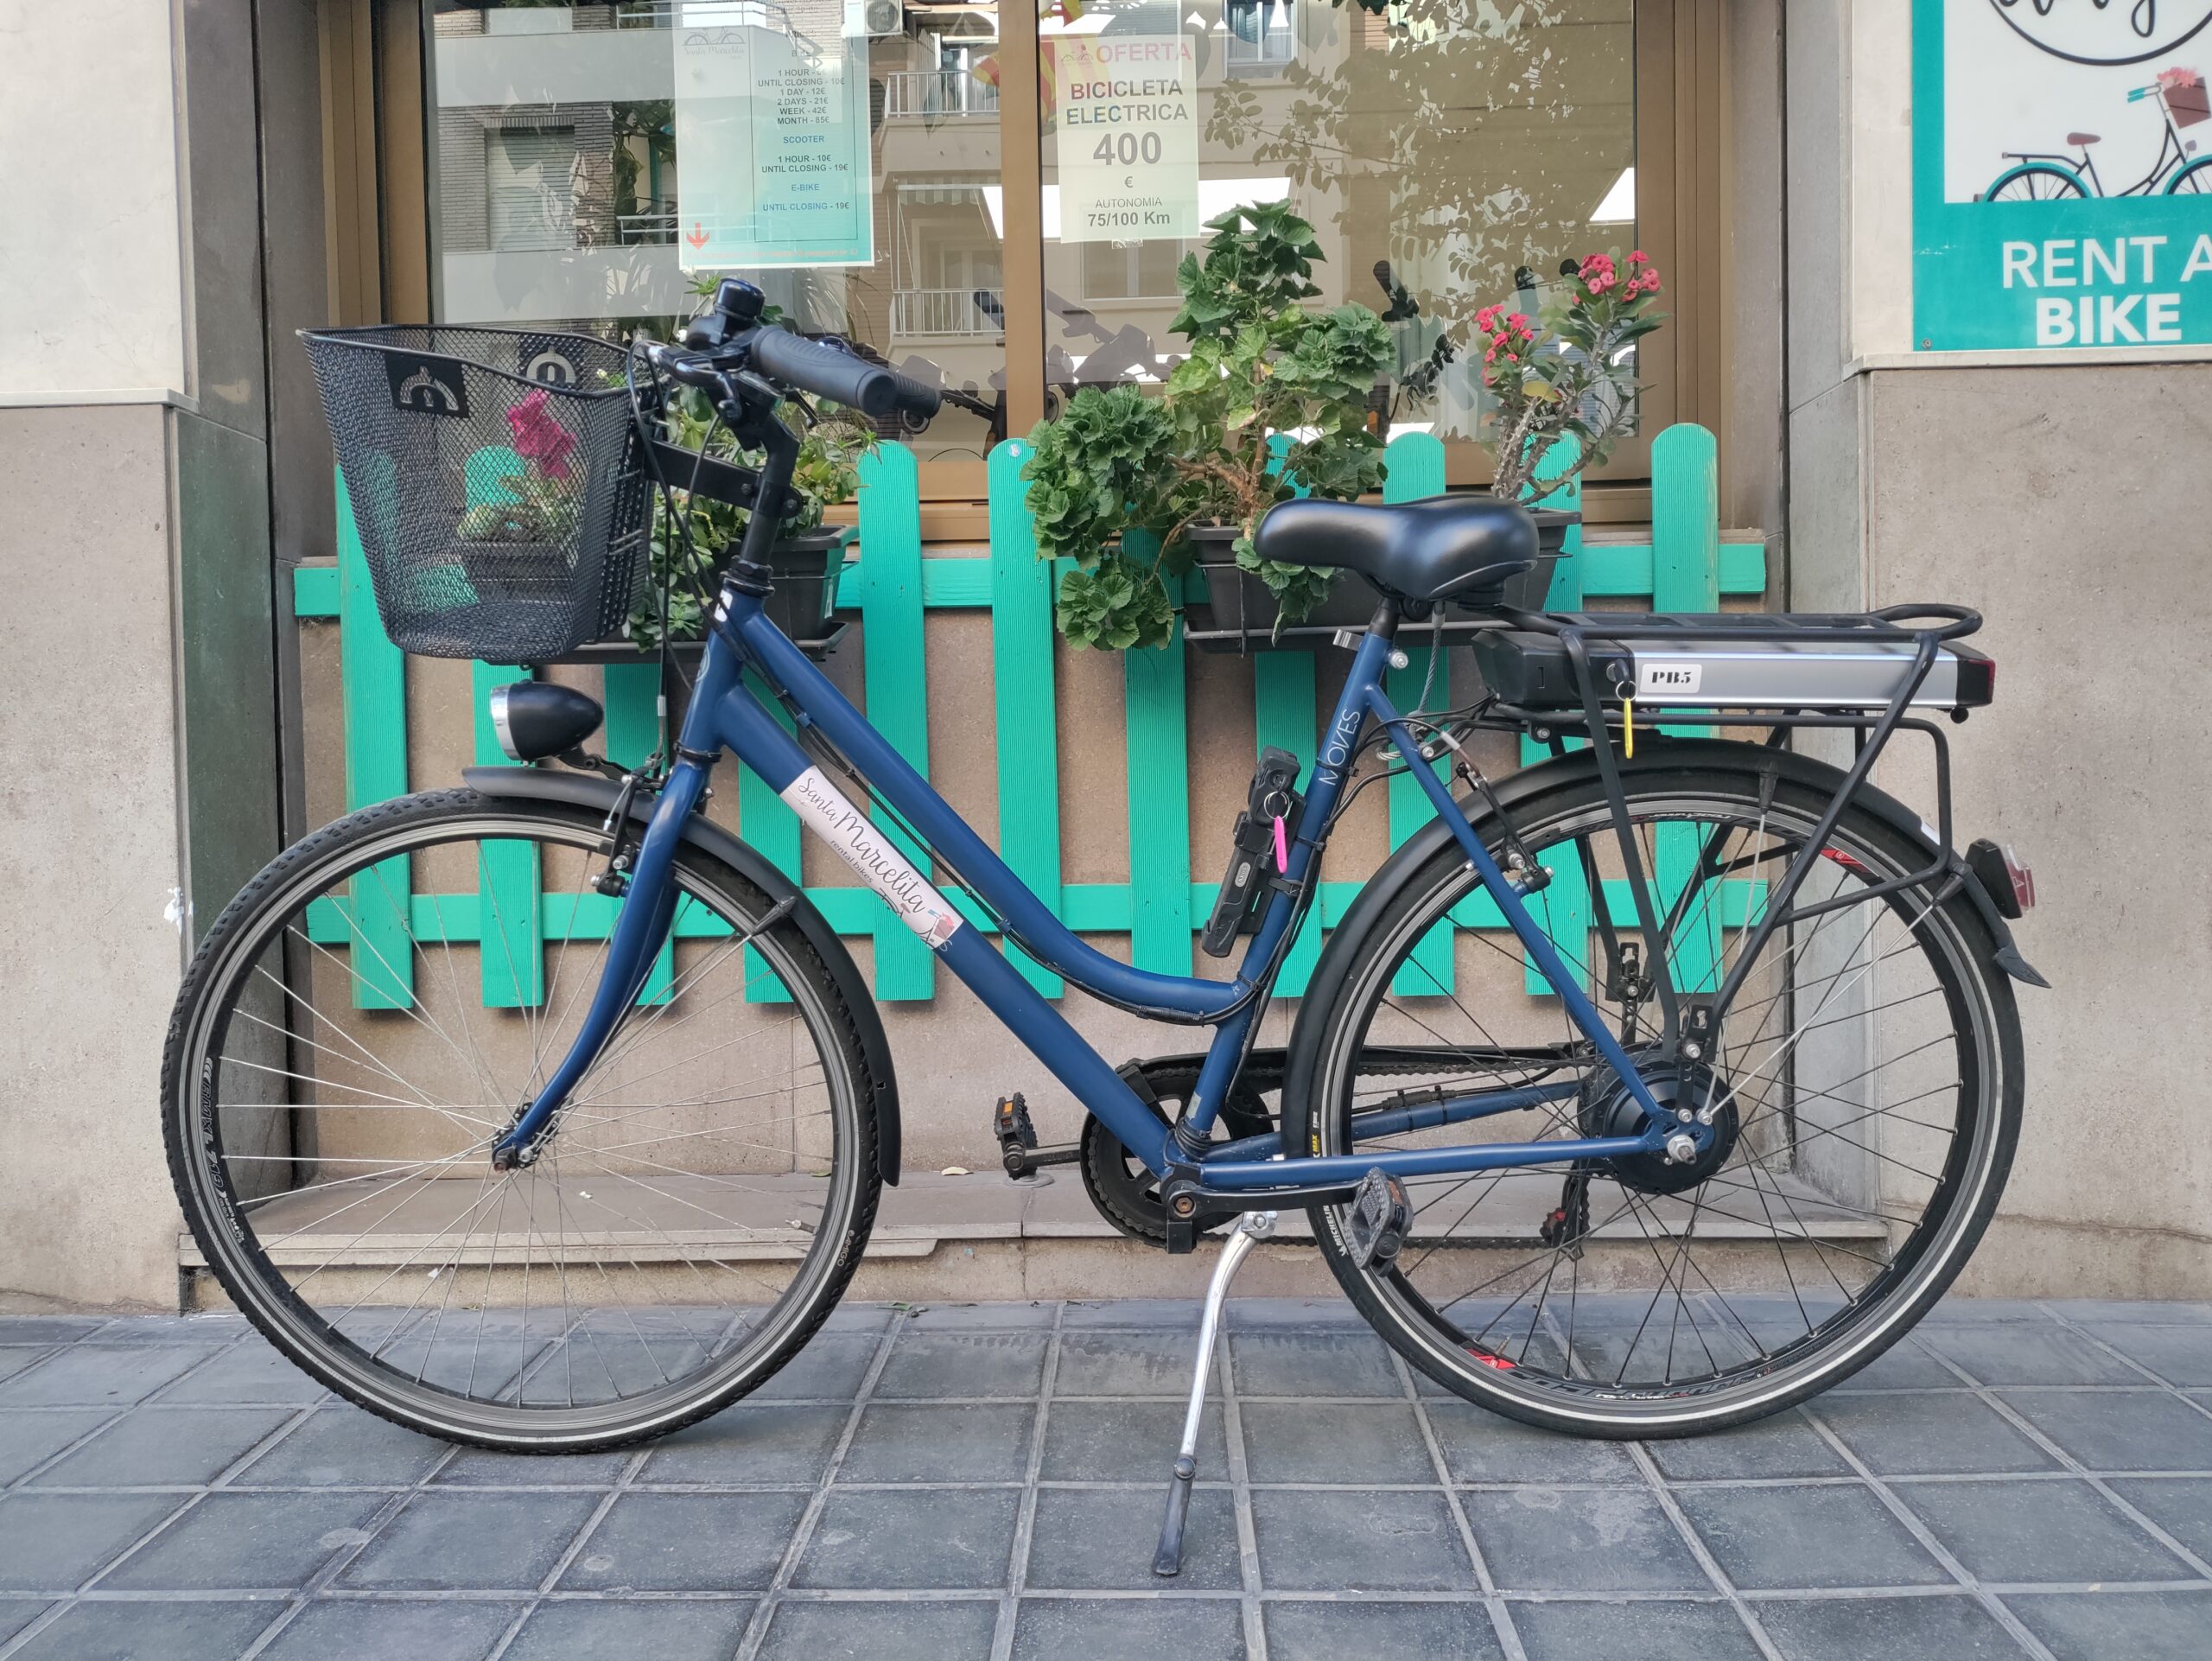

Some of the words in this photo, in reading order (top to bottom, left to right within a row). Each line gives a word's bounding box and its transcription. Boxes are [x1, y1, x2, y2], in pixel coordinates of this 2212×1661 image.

[1096, 42, 1192, 64] OFERTA
[758, 79, 783, 87] UNTIL
[785, 78, 823, 86] CLOSING
[1071, 79, 1184, 100] BICICLETA
[1066, 104, 1190, 125] ELECTRICA
[817, 154, 831, 162] 10€
[1092, 131, 1162, 166] 400
[791, 183, 820, 192] E-BIKE
[1123, 175, 1134, 188] €
[762, 203, 787, 212] UNTIL
[789, 202, 828, 211] CLOSING
[1095, 197, 1163, 209] AUTONOMIA
[1088, 212, 1139, 227] 75/100
[1144, 211, 1171, 226] Km
[2002, 235, 2168, 289] RENT
[2036, 293, 2183, 347] BIKE
[798, 777, 837, 822] Santa
[833, 811, 926, 914] Marcelita
[830, 839, 855, 867] rental
[853, 861, 874, 884] bikes
[1322, 1205, 1343, 1246] MICHELIN
[836, 1236, 853, 1267] AMIGO
